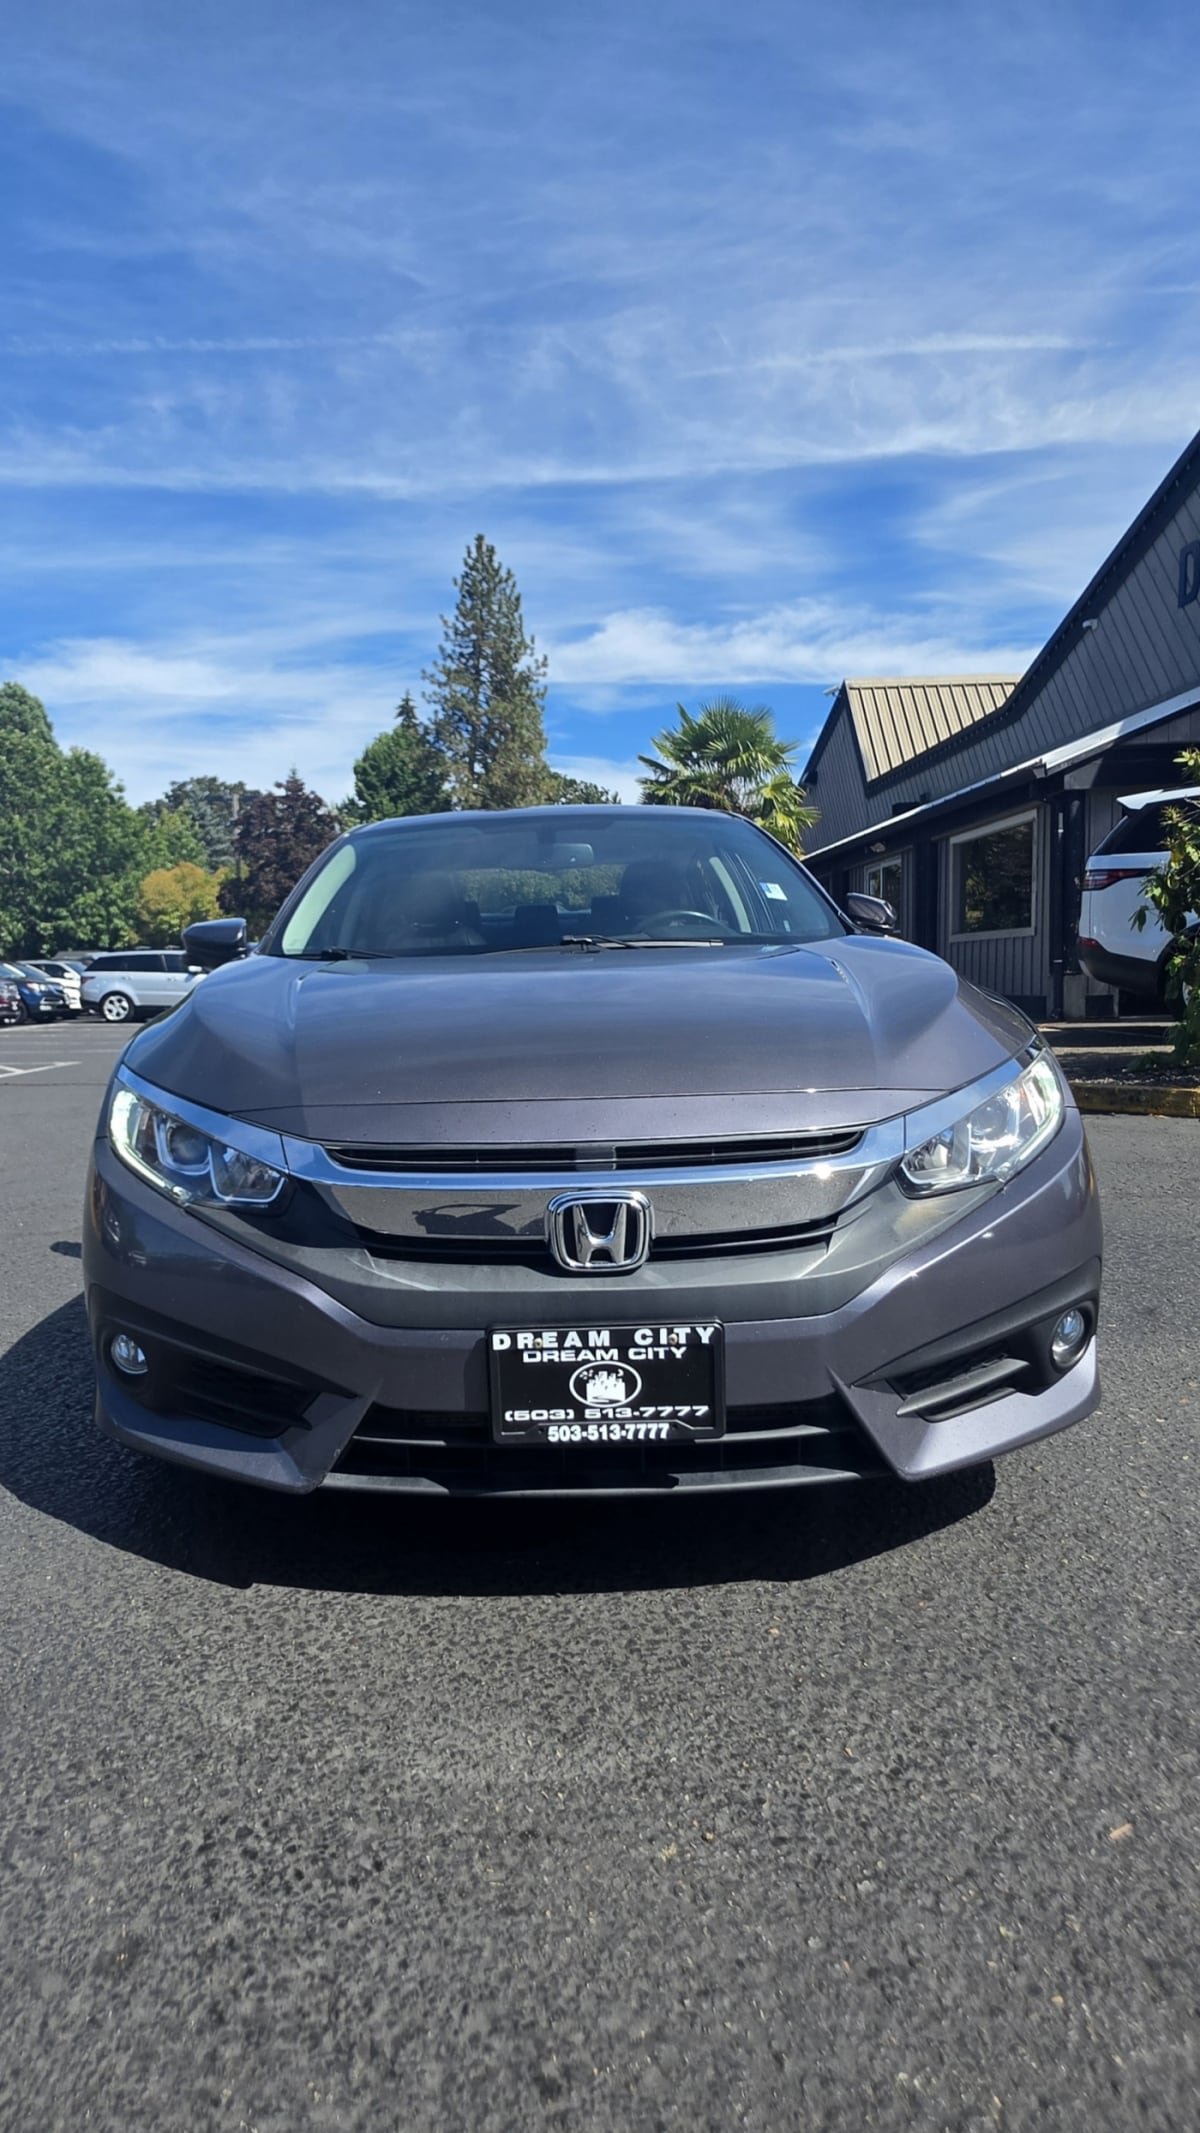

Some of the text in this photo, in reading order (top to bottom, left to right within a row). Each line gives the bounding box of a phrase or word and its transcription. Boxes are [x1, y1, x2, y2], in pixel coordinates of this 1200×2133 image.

[493, 1327, 715, 1350] DREAM CITY
[523, 1347, 687, 1363] DREAM CITY
[505, 1406, 709, 1421] (503) 513-7777
[548, 1423, 669, 1442] 503-513-7777
